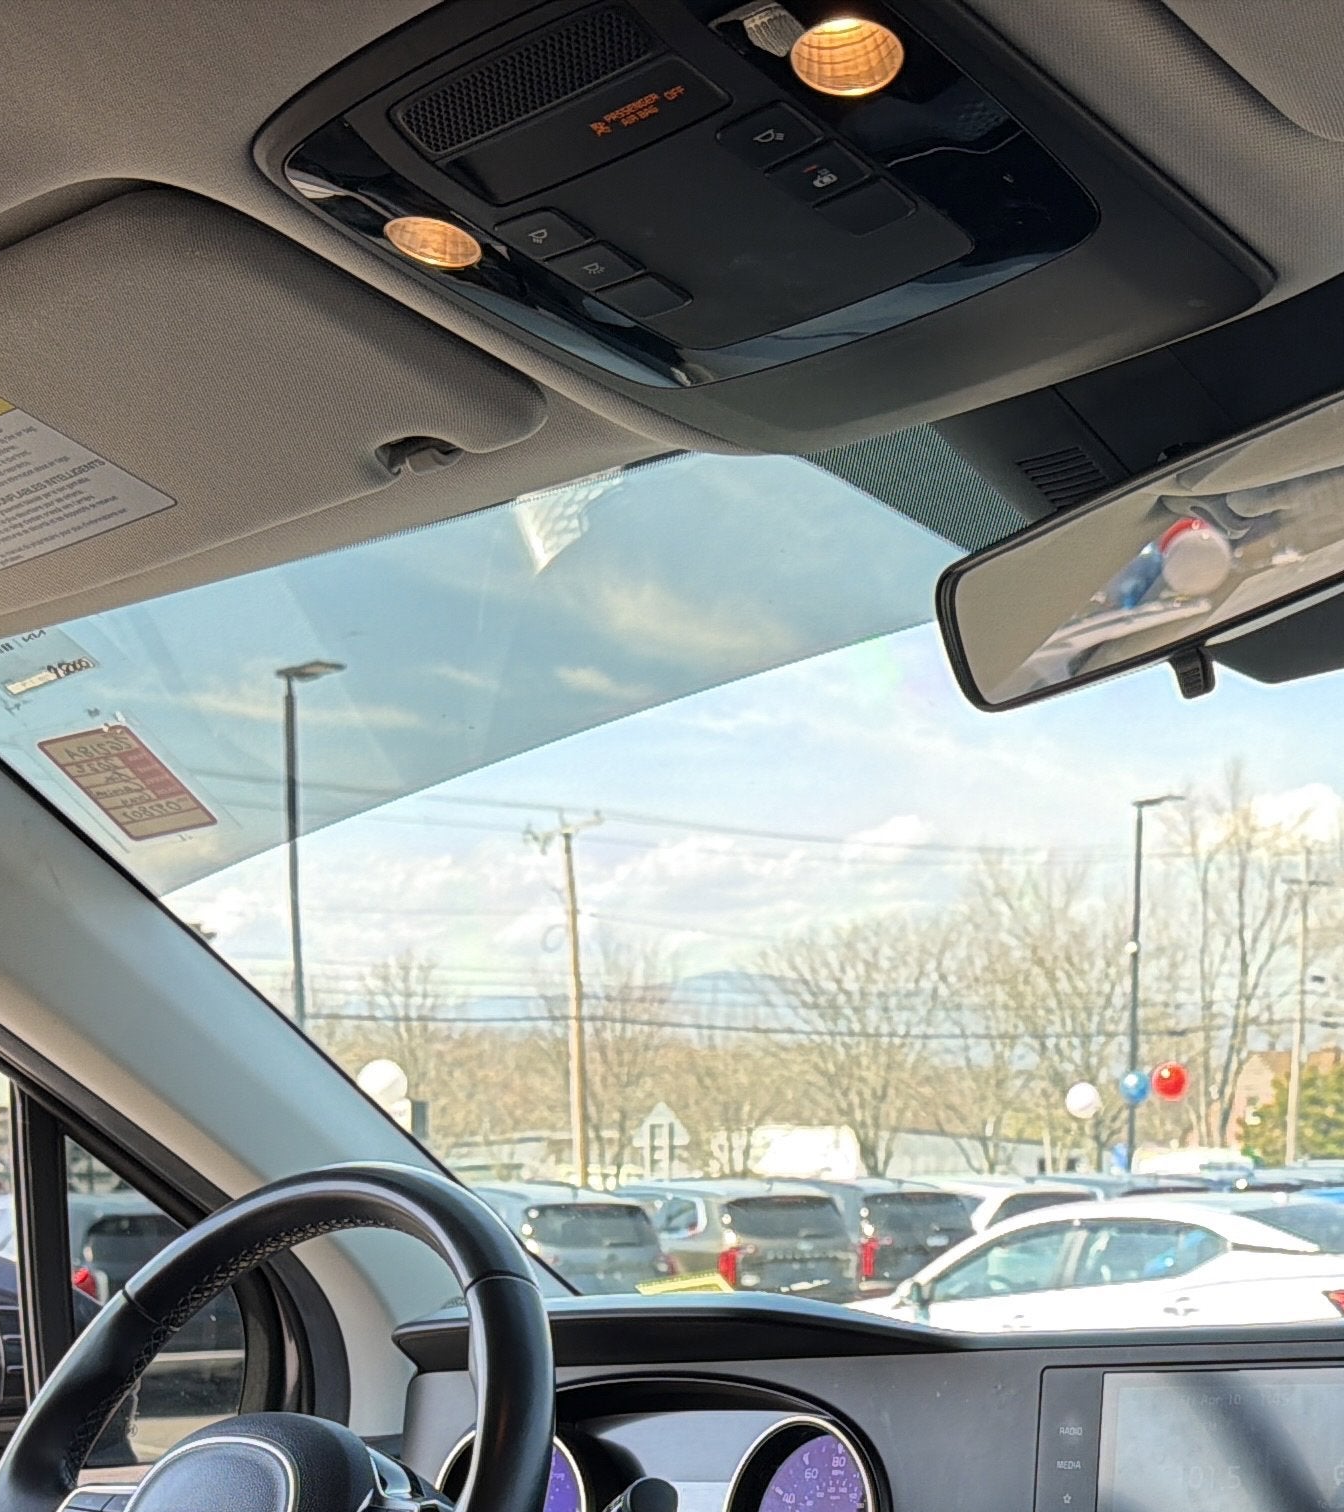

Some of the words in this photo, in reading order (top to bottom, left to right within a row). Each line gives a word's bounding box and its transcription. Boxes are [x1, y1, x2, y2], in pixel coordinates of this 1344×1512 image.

[1059, 1426, 1083, 1436] RADIO
[831, 1456, 846, 1467] 80
[1056, 1460, 1081, 1470] MEDIA
[804, 1468, 819, 1479] 60
